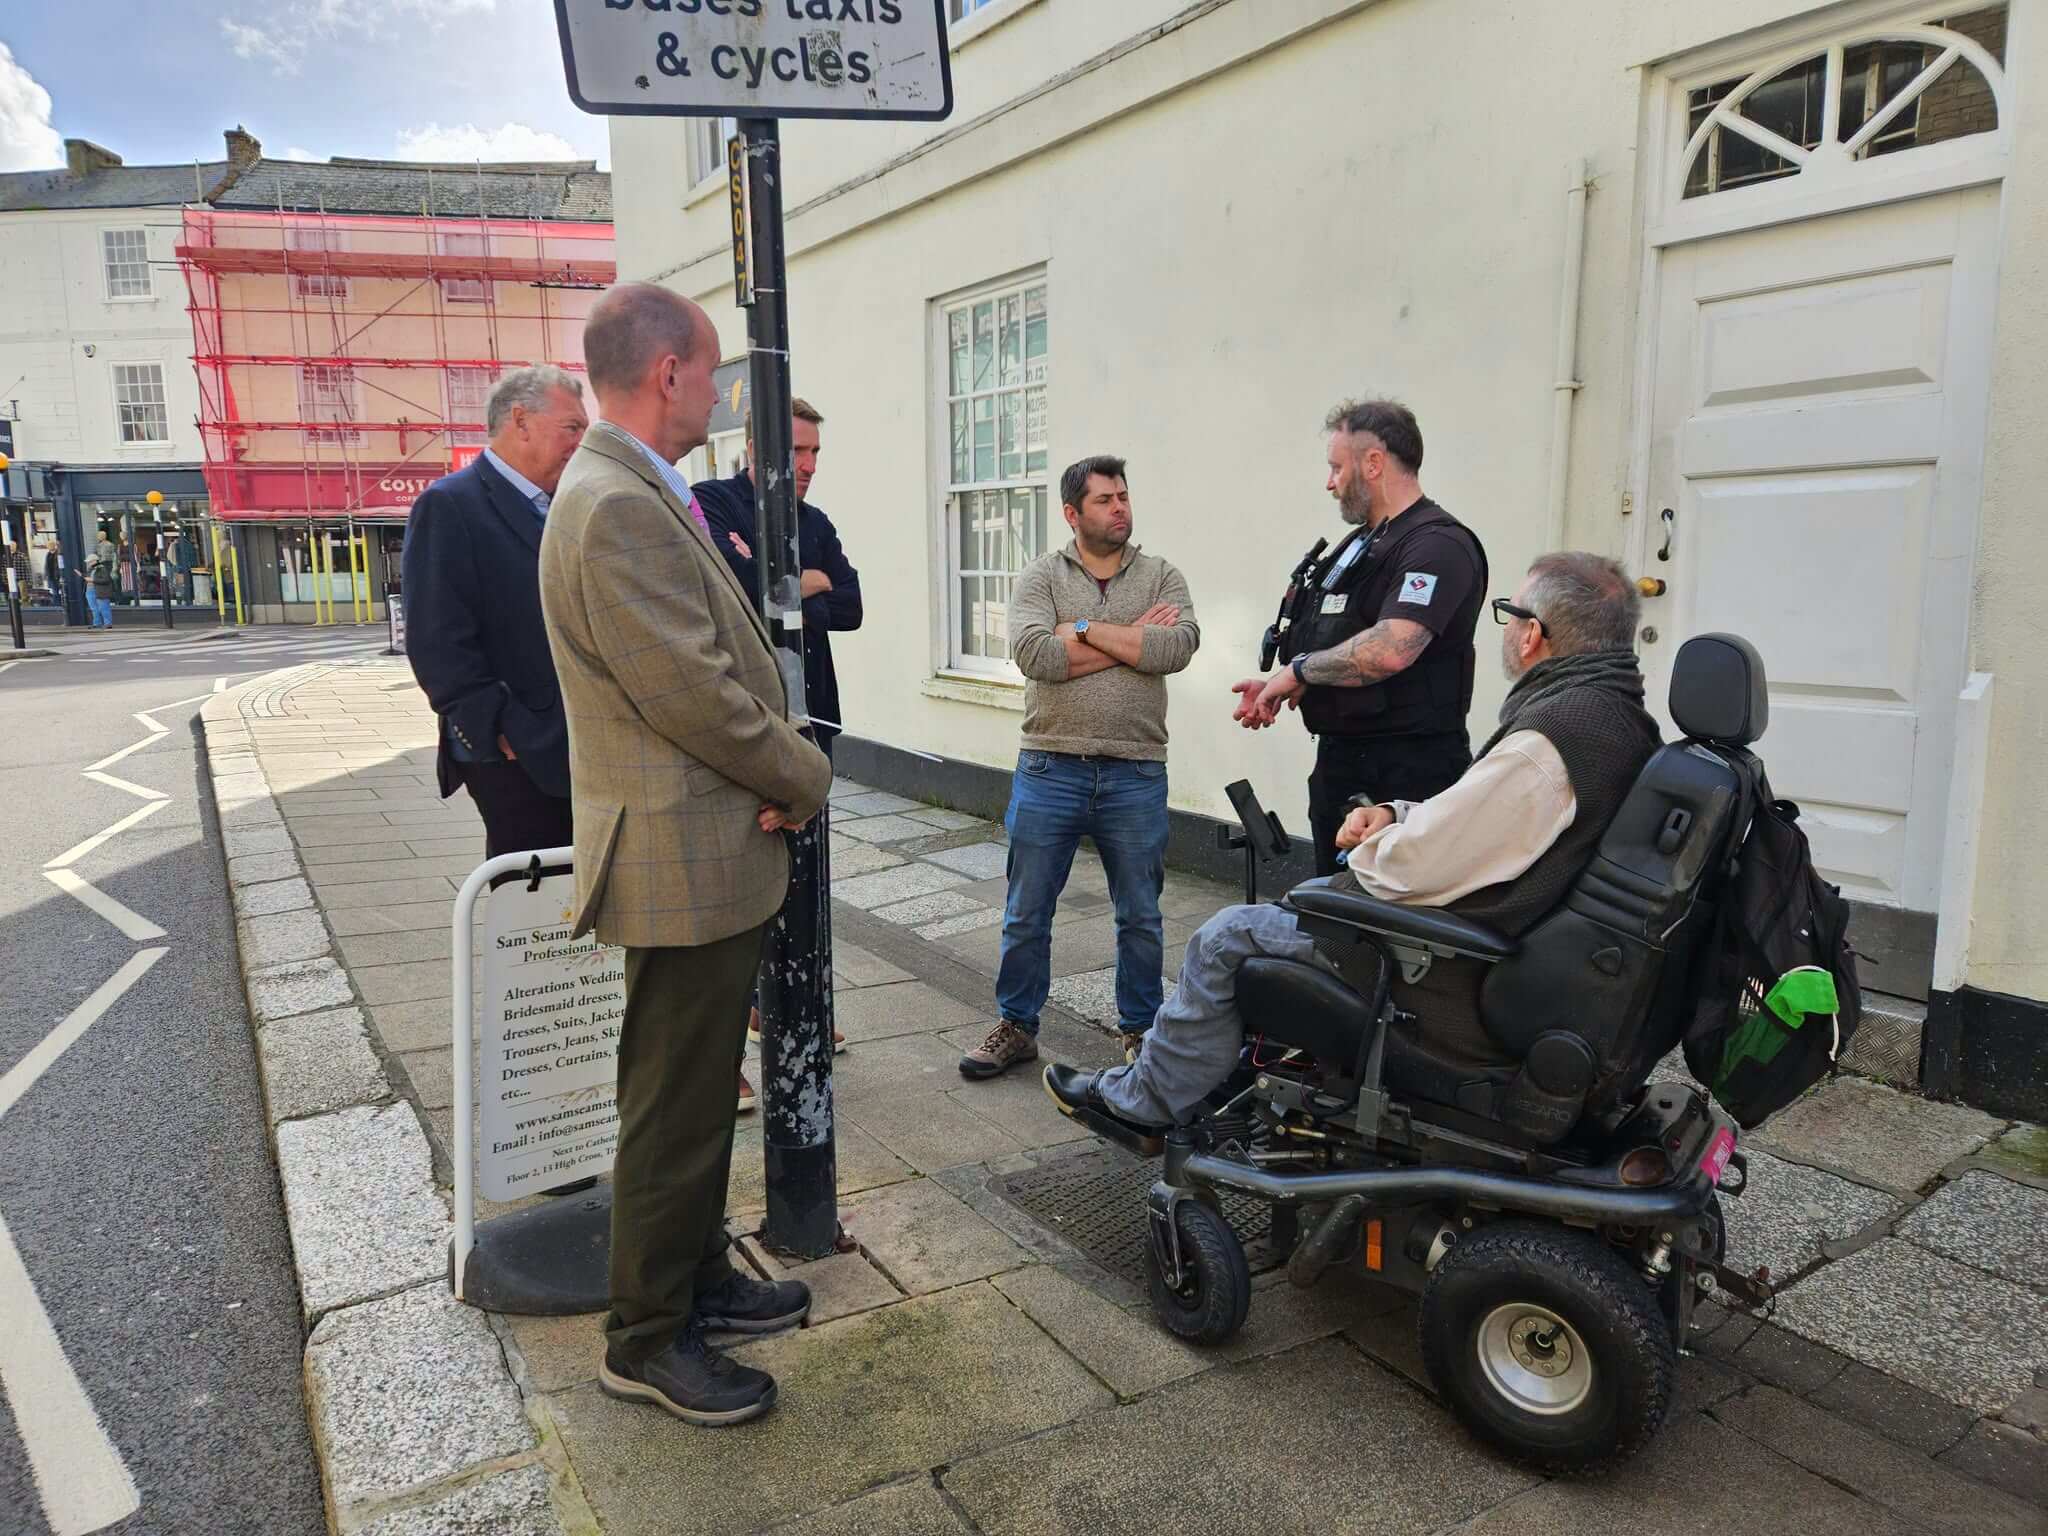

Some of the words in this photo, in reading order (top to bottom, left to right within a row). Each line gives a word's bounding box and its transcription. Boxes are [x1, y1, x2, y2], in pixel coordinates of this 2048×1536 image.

[656, 31, 691, 77] &
[711, 36, 872, 89] cycles
[730, 140, 746, 300] CS047
[496, 935, 527, 949] Sam
[531, 929, 573, 944] Seam
[524, 943, 598, 962] Professional
[504, 980, 575, 1001] Alterations
[579, 970, 624, 986] Weddin
[504, 997, 574, 1021] Bridesmaid
[578, 991, 622, 1006] dresses,
[503, 1024, 550, 1041] dresses,
[554, 1016, 587, 1031] Suits,
[589, 1008, 625, 1026] Jacket
[502, 1041, 561, 1061] Trousers,
[563, 1033, 599, 1051] Jeans,
[602, 1026, 620, 1040] Ski
[502, 1063, 552, 1081] Dresses,
[555, 1050, 611, 1068] Curtains,
[501, 1088, 531, 1101] etc...
[515, 1099, 616, 1132] www.samseamstr
[492, 1135, 528, 1154] Email
[553, 1146, 573, 1158] Next
[575, 1143, 584, 1152] to
[586, 1134, 618, 1149] Cathedr
[507, 1171, 530, 1184] Floor
[532, 1168, 540, 1177] 2,
[555, 1158, 577, 1171] High
[578, 1152, 604, 1164] Cross,
